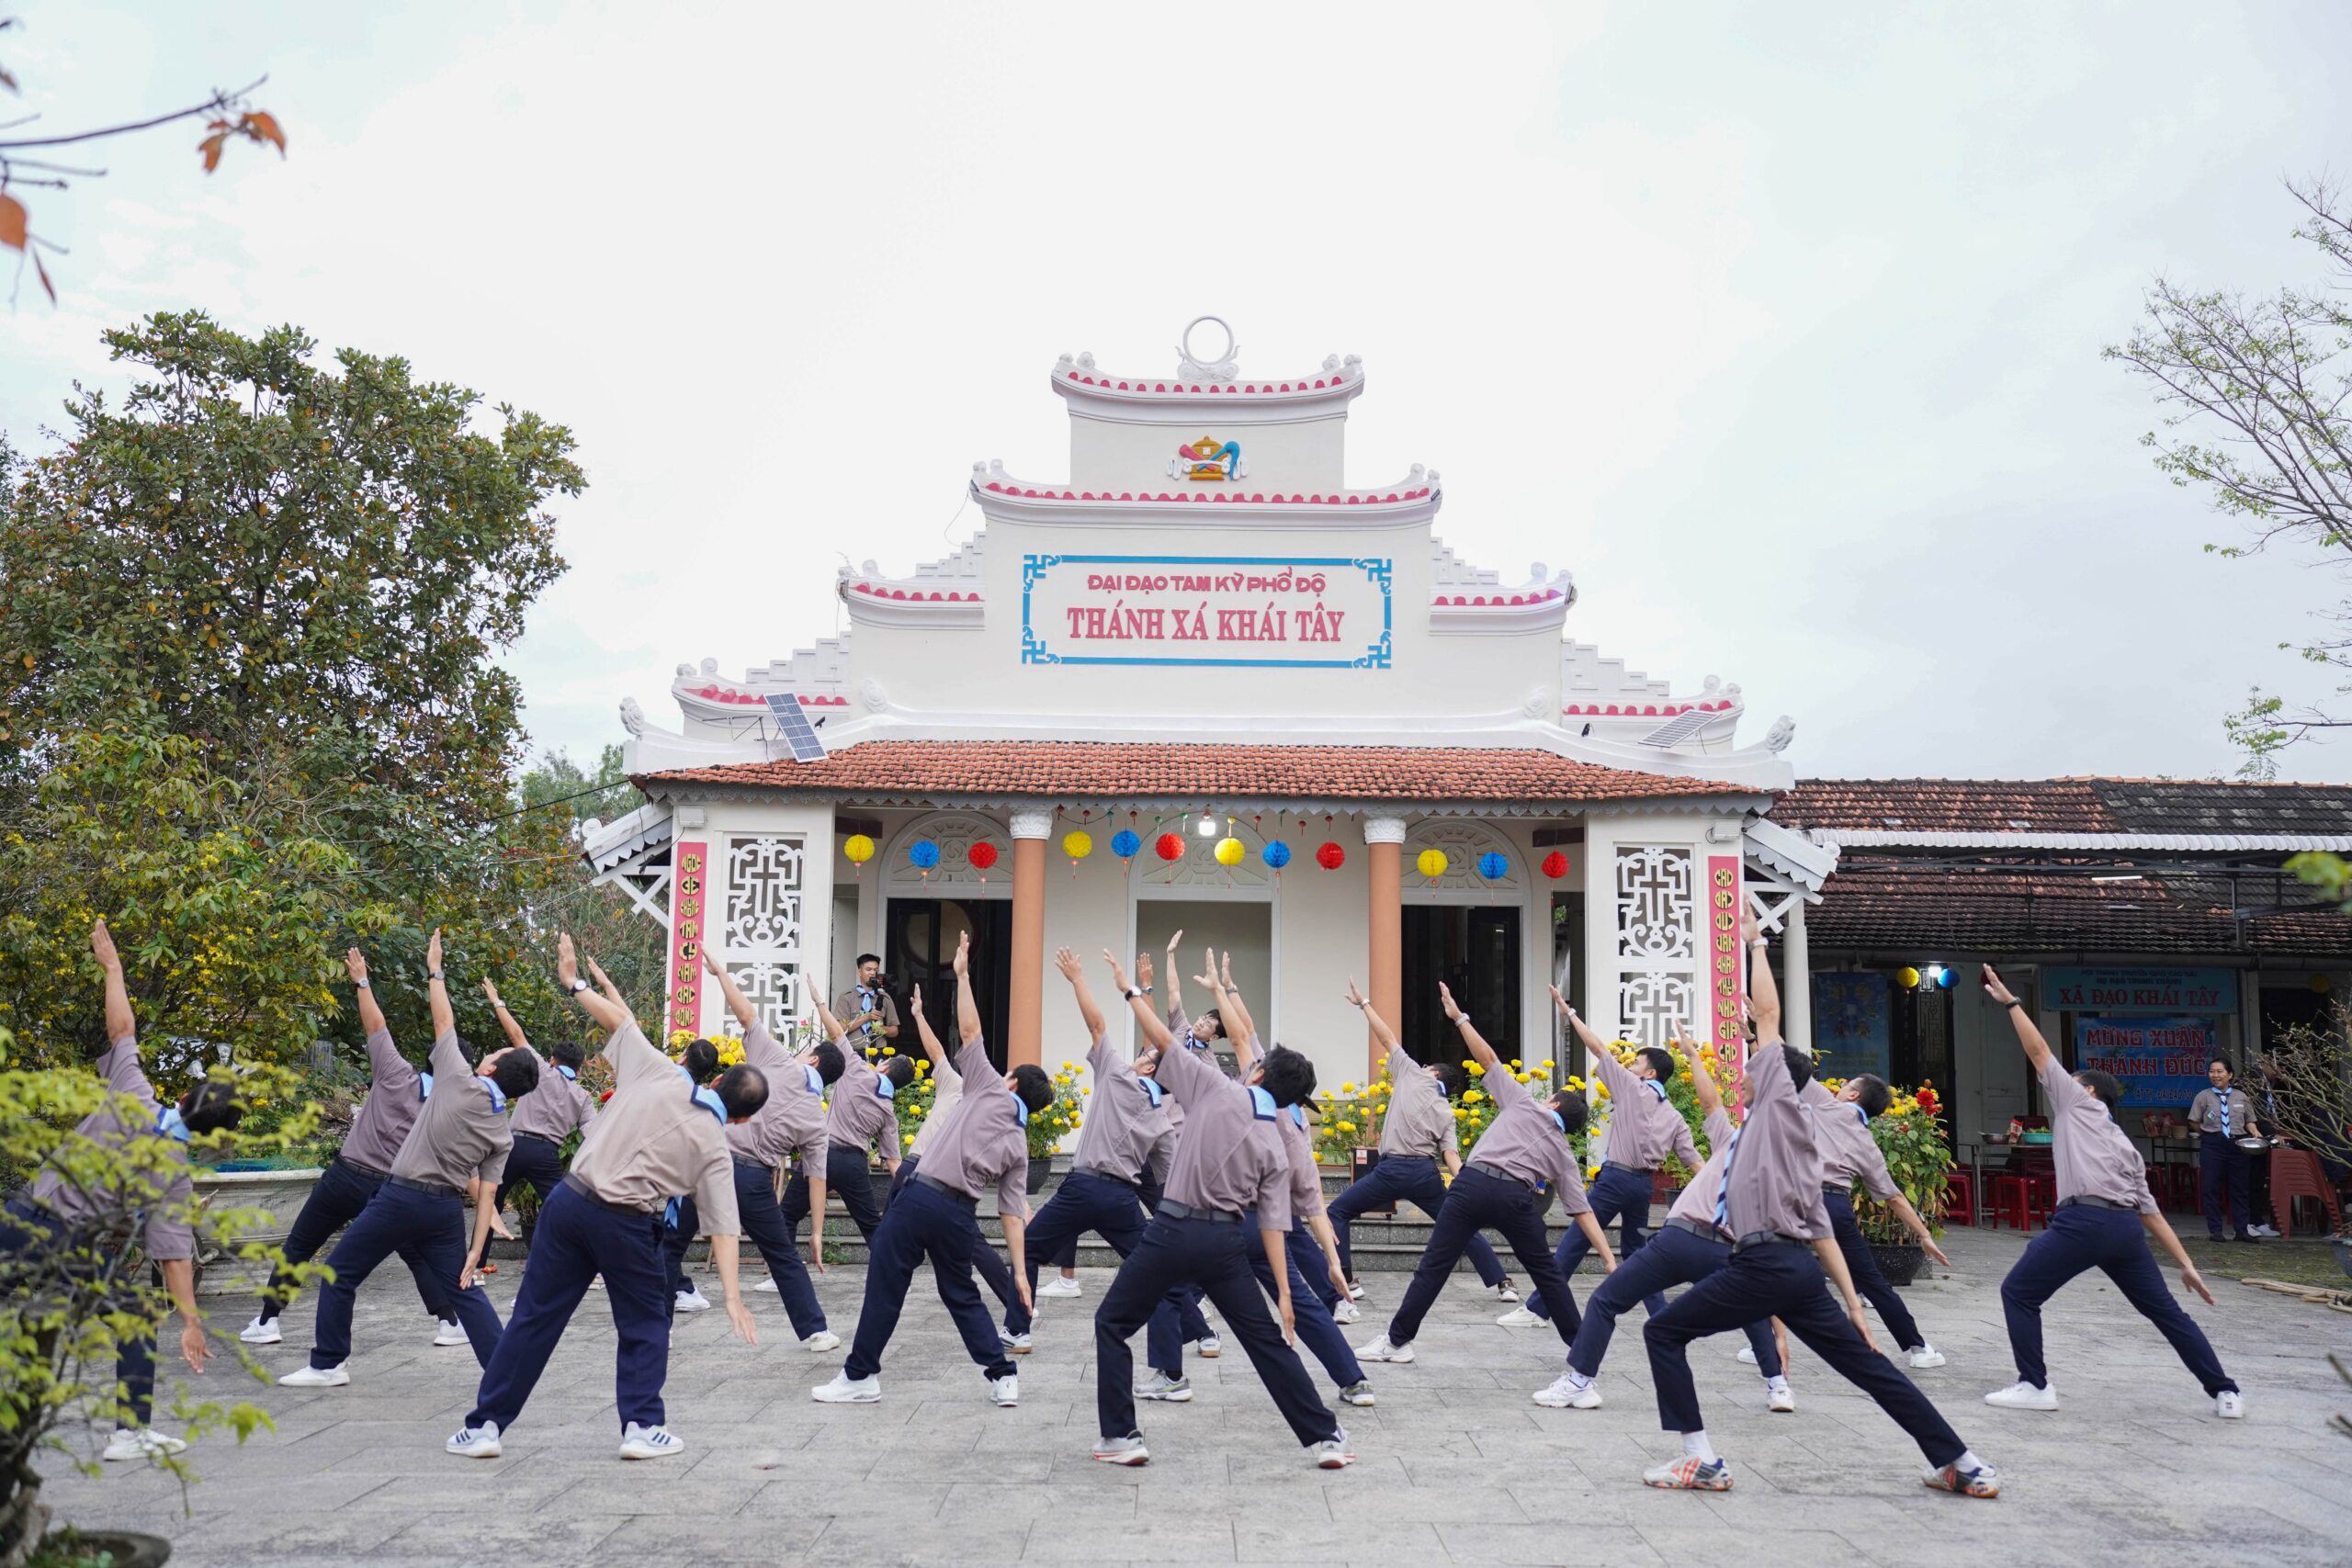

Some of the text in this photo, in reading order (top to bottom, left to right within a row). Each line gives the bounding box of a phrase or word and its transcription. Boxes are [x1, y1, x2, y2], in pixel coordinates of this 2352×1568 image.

[1088, 566, 1327, 597] ĐẠI ĐẠO TAM KỲ PHỔ ĐỘ
[1067, 599, 1346, 642] THÁNH XÁ KHÁI TÂY
[2059, 985, 2220, 1008] XÃ ĐẠO KHÁI TÂY
[2086, 1026, 2205, 1047] MỪNG XUÂN
[2086, 1055, 2206, 1077] THÁNH ĐỨC
